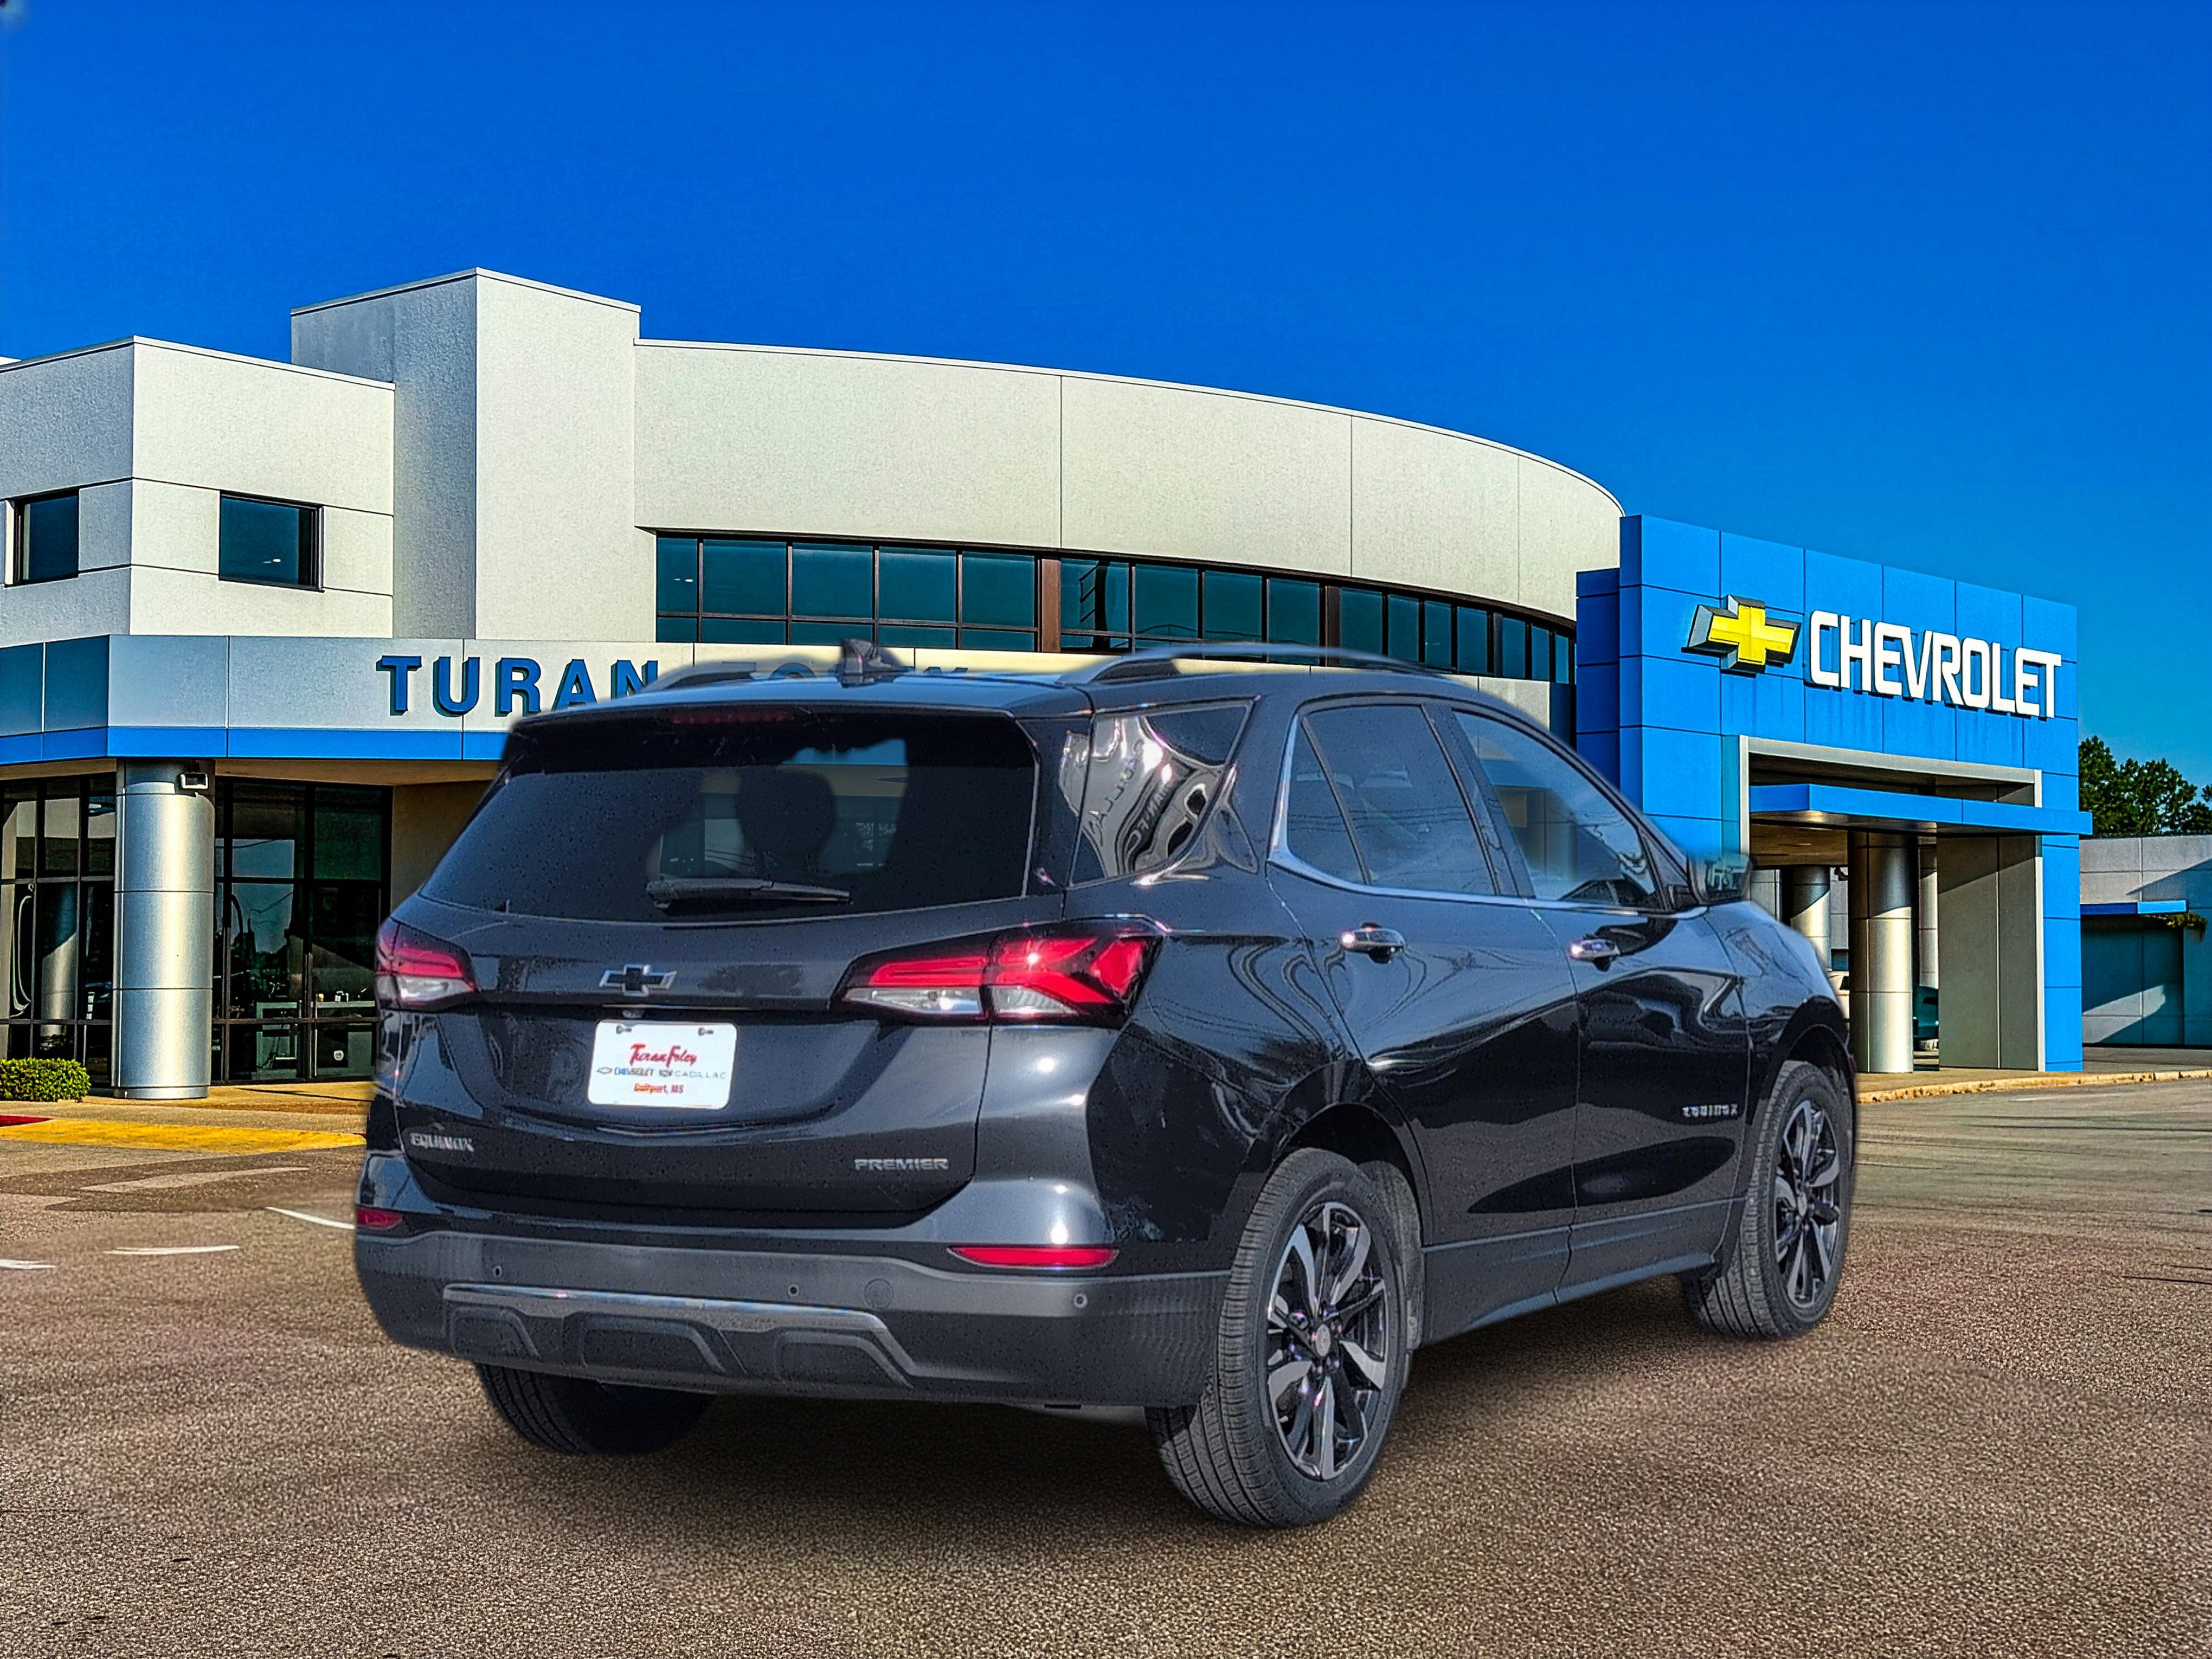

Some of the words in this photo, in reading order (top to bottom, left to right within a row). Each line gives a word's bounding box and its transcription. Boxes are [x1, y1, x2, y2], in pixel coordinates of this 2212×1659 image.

[377, 655, 659, 716] TURAN
[1810, 610, 2062, 718] CHEVROLET
[854, 1158, 949, 1170] PREMIER
